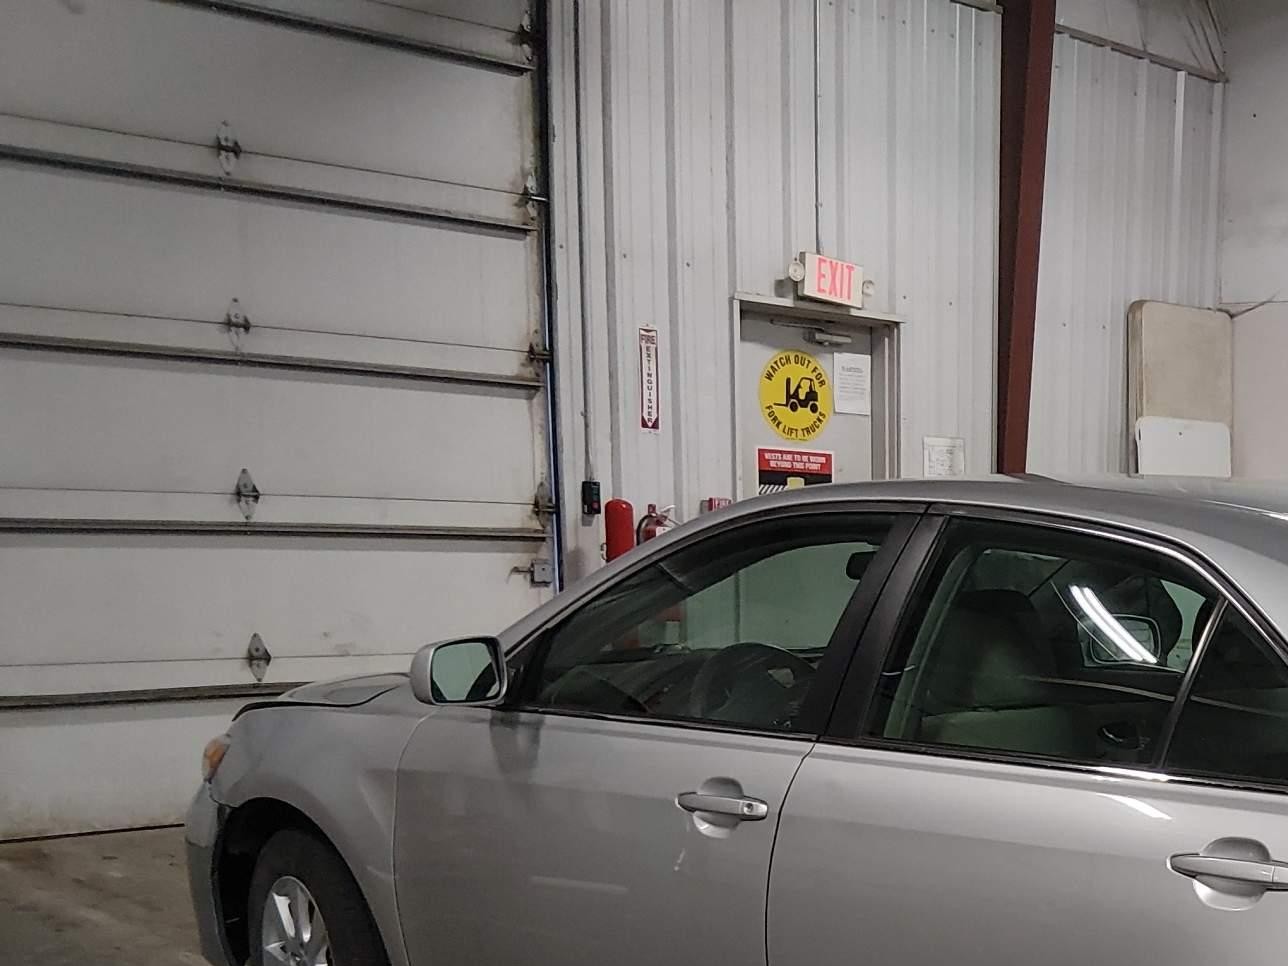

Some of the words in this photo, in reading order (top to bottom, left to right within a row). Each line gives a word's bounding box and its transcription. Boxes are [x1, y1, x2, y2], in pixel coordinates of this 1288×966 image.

[817, 257, 855, 301] EXIT
[640, 334, 656, 344] FIRE
[645, 345, 653, 423] EXTINGUISHER
[764, 354, 792, 382] WATCH
[794, 354, 811, 369] OUT
[811, 366, 826, 388] FOR
[765, 405, 782, 429] FORK
[782, 426, 799, 438] LIFT
[801, 411, 827, 438] TRUCKS
[769, 460, 792, 468] BEYOND
